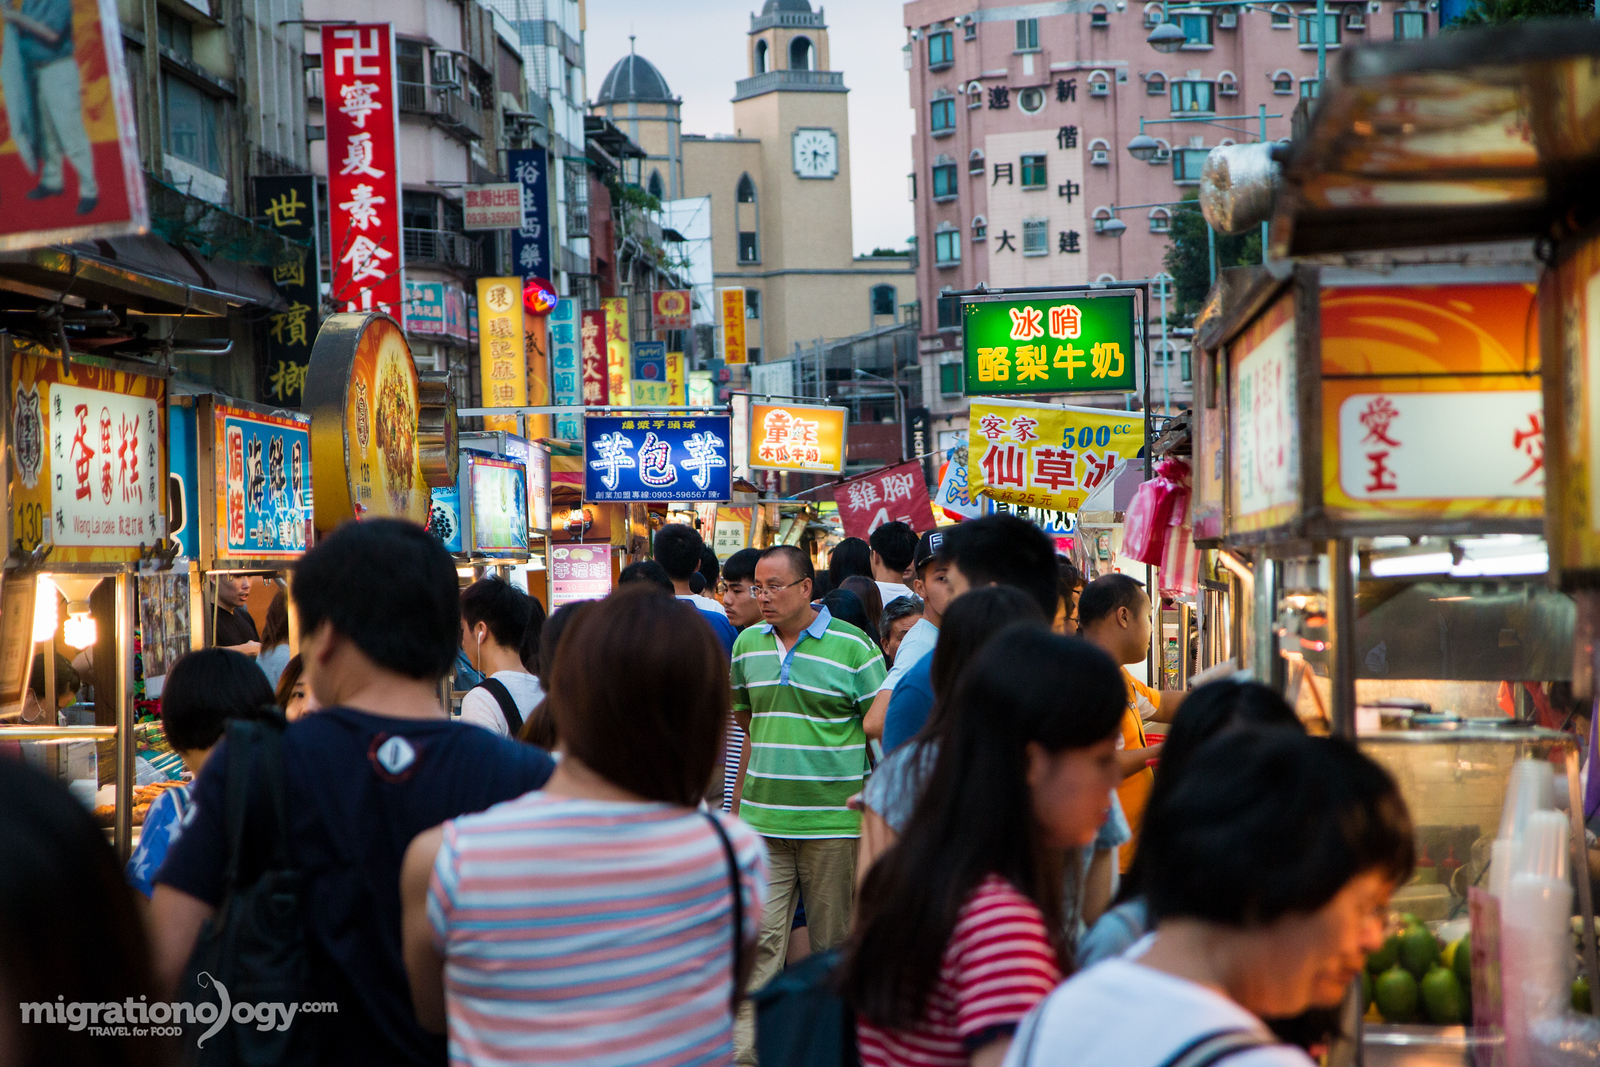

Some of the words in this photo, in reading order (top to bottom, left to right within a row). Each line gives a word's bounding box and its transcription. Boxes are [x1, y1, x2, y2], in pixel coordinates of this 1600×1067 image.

[466, 188, 520, 208] 套房出租
[514, 160, 543, 280] 裕生西藥
[489, 286, 509, 308] 環
[1009, 304, 1082, 341] 冰哨
[977, 342, 1125, 382] 酪梨牛奶
[621, 420, 696, 430] 爆漿芋頭球
[764, 410, 818, 446] 童年
[980, 415, 1039, 443] 客家
[1062, 424, 1131, 449] 500cc
[590, 431, 726, 490] 芋包芋
[760, 445, 819, 463] 木瓜牛奶
[1359, 397, 1402, 492] 愛玉
[228, 430, 245, 541] 焗烤
[361, 462, 371, 483] 126
[848, 474, 913, 512] 雞腳
[18, 501, 43, 543] 130
[72, 515, 91, 538] Wang
[554, 562, 607, 579] 芋泥球
